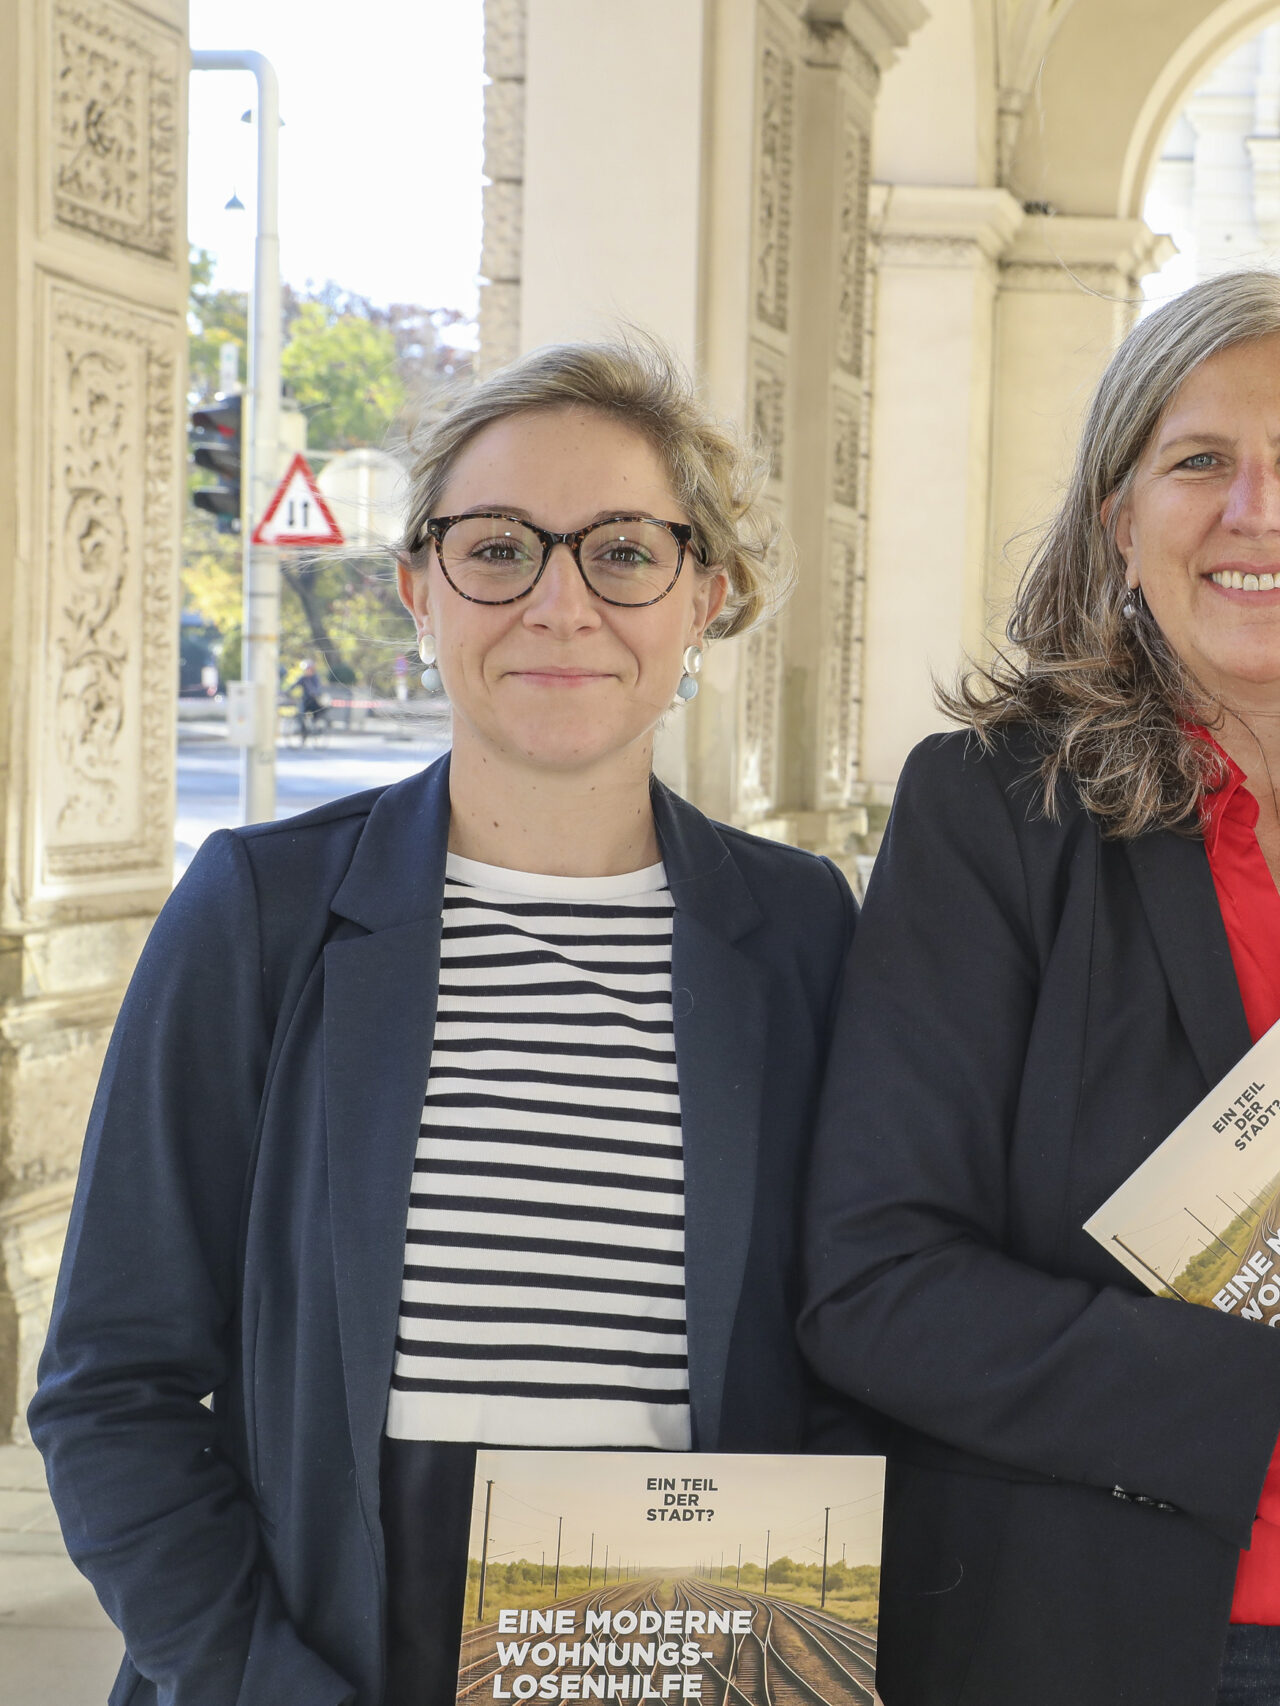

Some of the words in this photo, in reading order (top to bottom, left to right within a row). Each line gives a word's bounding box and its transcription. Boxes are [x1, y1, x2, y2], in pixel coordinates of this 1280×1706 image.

[1212, 1107, 1237, 1134] EIN
[1233, 1081, 1265, 1109] TEIL
[1234, 1101, 1263, 1131] DER
[1211, 1250, 1274, 1313] EINE
[647, 1478, 676, 1491] EIN
[681, 1479, 718, 1491] TEIL
[664, 1493, 699, 1506] DER
[647, 1508, 715, 1522] STADT?
[498, 1609, 576, 1634] EINE
[585, 1610, 752, 1634] MODERNE
[496, 1641, 714, 1667] WOHNUNGS-
[492, 1674, 703, 1699] LOSENHILFE
